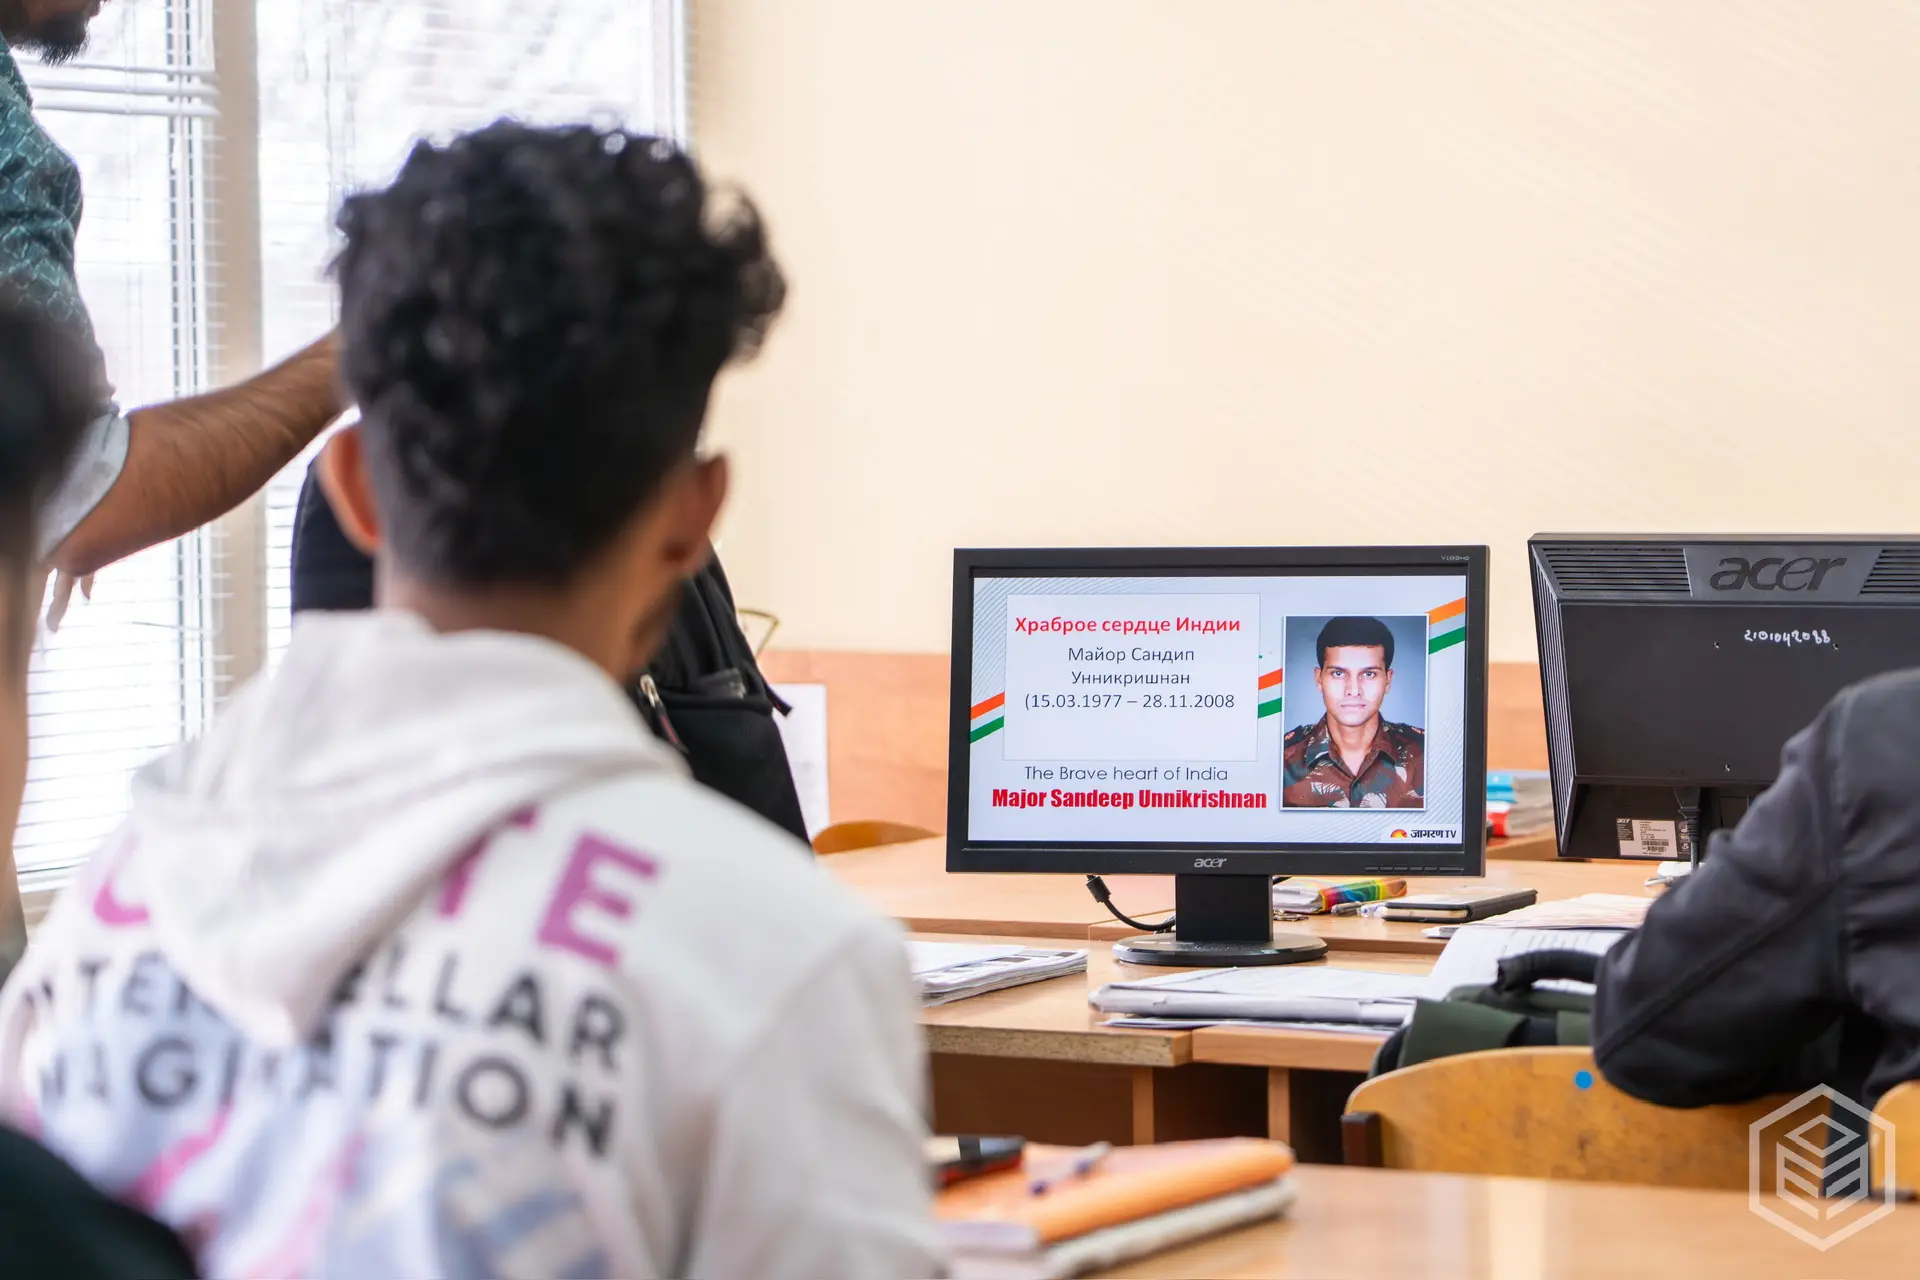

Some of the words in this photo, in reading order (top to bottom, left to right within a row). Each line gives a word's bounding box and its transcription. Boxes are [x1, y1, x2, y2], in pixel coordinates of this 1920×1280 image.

[1710, 556, 1847, 592] acer
[1014, 615, 1098, 636] Храброе
[1101, 620, 1171, 636] сердце
[1175, 616, 1241, 635] Индии
[1068, 646, 1126, 665] Майор
[1131, 647, 1195, 664] Сандип
[1071, 670, 1190, 687] Унникришнан
[1024, 693, 1122, 711] (15.03.1977
[1142, 694, 1235, 708] 28.11.2008
[1024, 765, 1054, 781] The
[1059, 766, 1108, 781] Brave
[1113, 766, 1159, 781] heart
[1163, 766, 1181, 781] of
[1186, 766, 1228, 781] India
[992, 788, 1047, 810] Major
[1050, 788, 1135, 810] Sandeep
[1138, 788, 1267, 809] Unnikrishnan
[1410, 829, 1444, 839] जागरण
[1445, 829, 1457, 839] TV
[1193, 858, 1228, 868] acer
